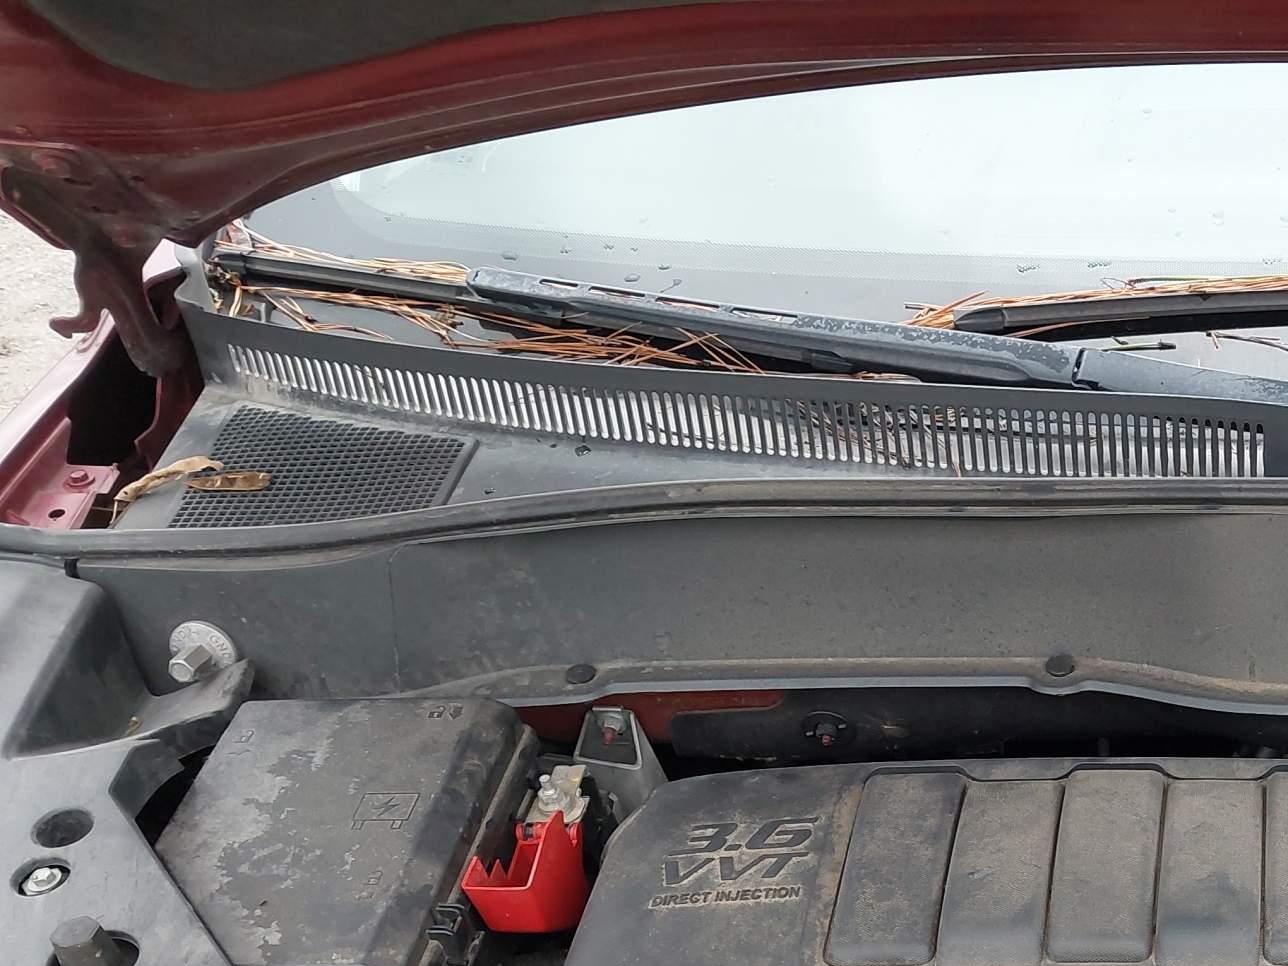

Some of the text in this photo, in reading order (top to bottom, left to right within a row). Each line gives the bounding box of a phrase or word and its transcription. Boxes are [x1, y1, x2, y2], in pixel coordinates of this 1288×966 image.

[668, 816, 819, 857] 3.6
[664, 851, 809, 886] VVT
[650, 886, 801, 908] DIRECT INJECTION
